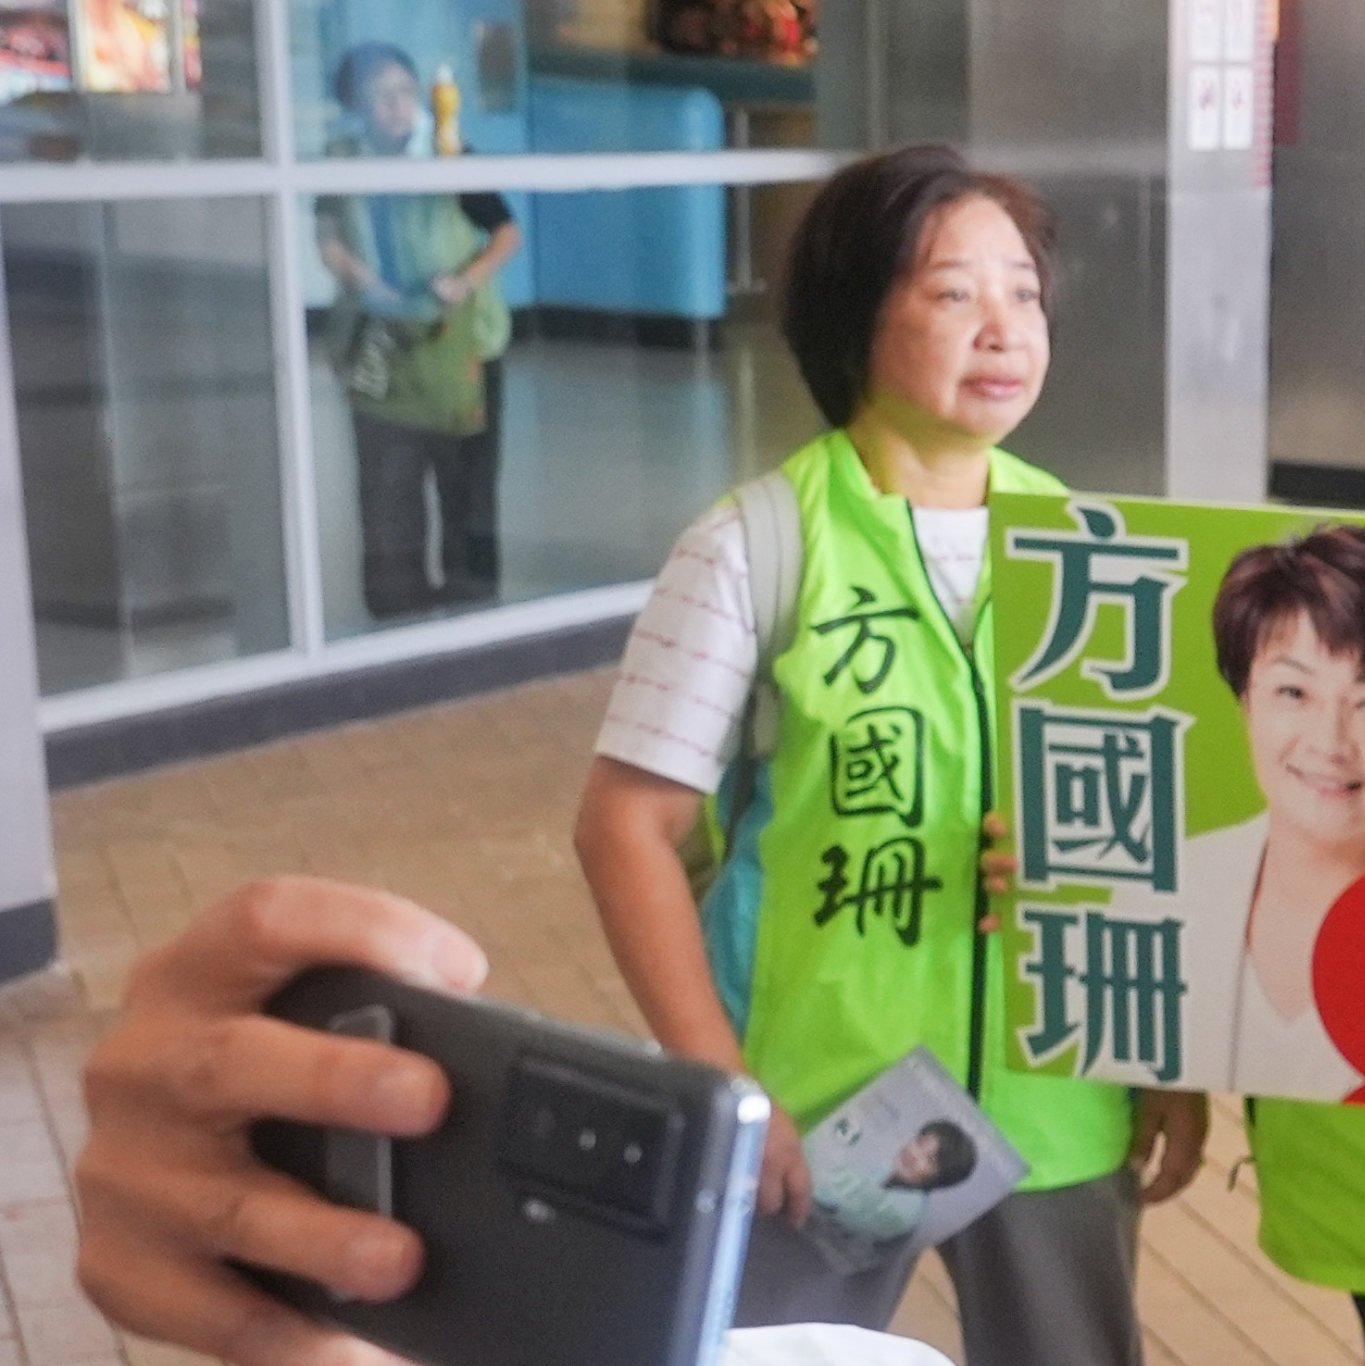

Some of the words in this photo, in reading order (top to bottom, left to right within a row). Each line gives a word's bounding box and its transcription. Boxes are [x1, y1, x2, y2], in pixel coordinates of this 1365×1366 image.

[811, 585, 944, 947] 方國珊
[1006, 503, 1192, 1083] 方國珊
